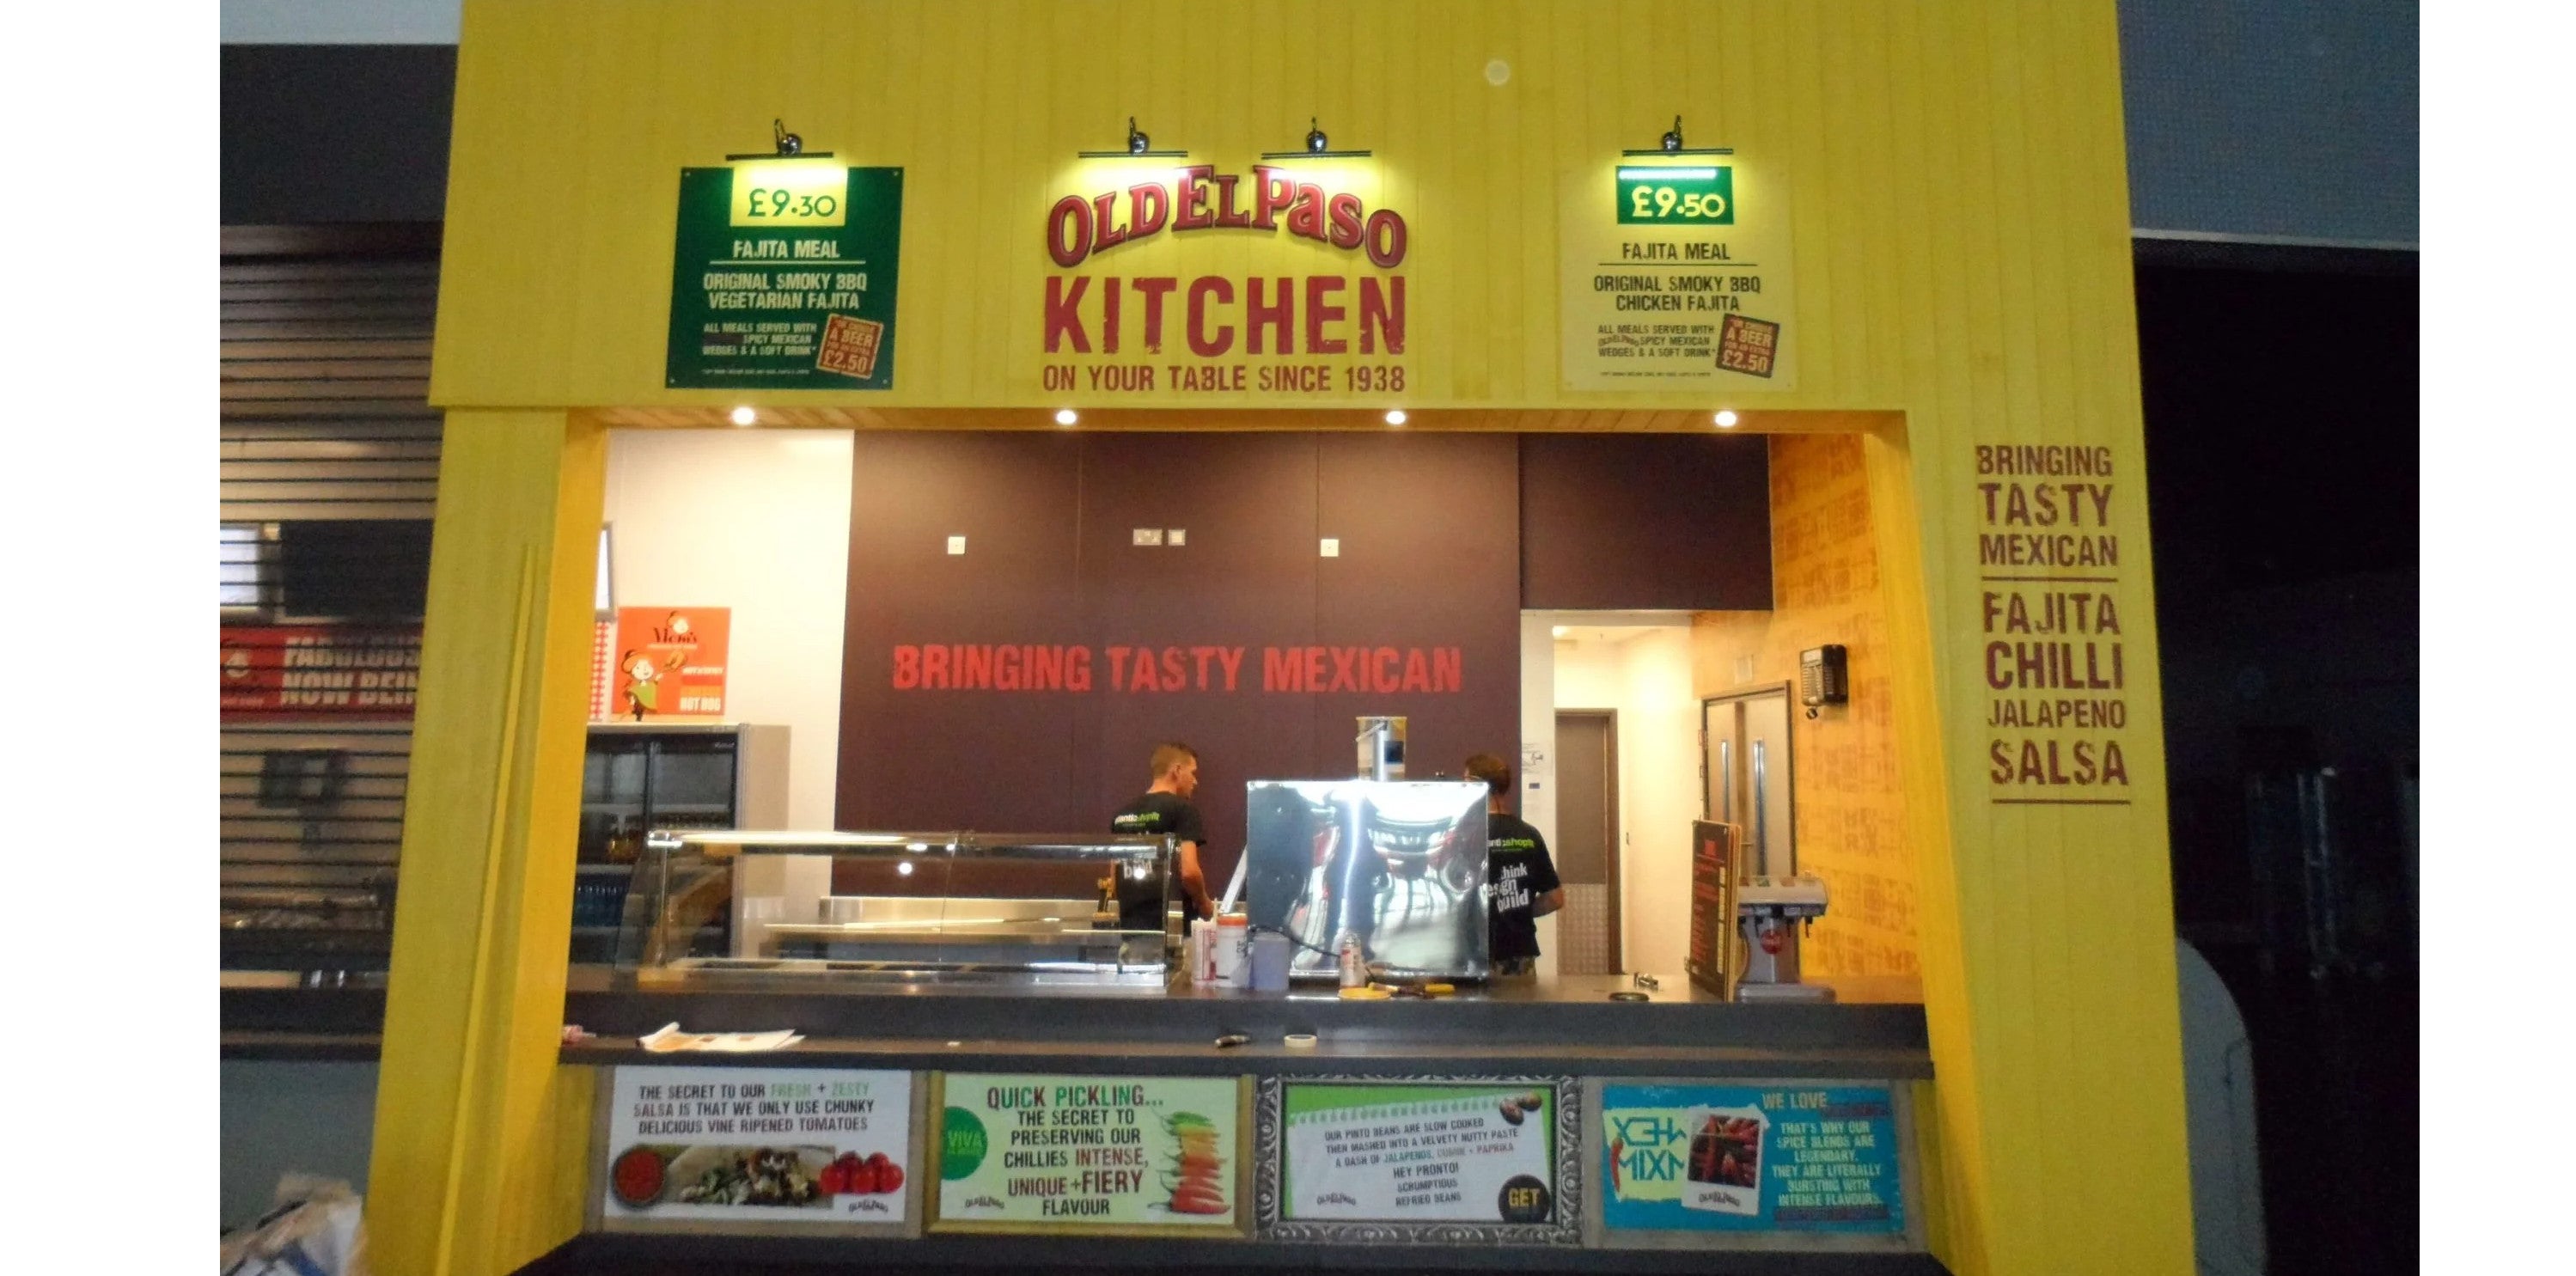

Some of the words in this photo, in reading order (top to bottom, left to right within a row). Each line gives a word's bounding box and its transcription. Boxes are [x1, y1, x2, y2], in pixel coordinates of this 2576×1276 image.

[748, 188, 836, 217] £9.30
[1632, 186, 1725, 217] £9.50
[733, 240, 788, 258] FAJITA
[794, 240, 840, 258] MEAL
[1622, 242, 1678, 259] FAJITA
[1684, 243, 1731, 259] MEAL
[703, 273, 771, 290] ORIGINAL
[776, 273, 831, 290] SMOKY
[836, 273, 867, 291] BBQ
[1594, 275, 1662, 292] ORIGINAL
[1669, 276, 1724, 293] SMOKY
[1730, 276, 1761, 294] BBQ
[709, 292, 803, 309] VEGETARIAN
[808, 292, 859, 309] FAJITA
[1616, 295, 1682, 311] CHICKEN
[1687, 295, 1740, 311] FAJITA
[1044, 276, 1405, 357] KITCHEN
[704, 322, 720, 333] ALL
[1598, 325, 1614, 334] ALL
[1616, 325, 1650, 334] MEALS
[1652, 325, 1687, 334] SERVED
[1691, 325, 1714, 334] WITH
[1726, 327, 1736, 341] A
[1639, 336, 1665, 345] SPICY
[1670, 336, 1710, 345] MEXICAN
[1598, 347, 1634, 357] WEDGES
[1648, 347, 1655, 357] A
[1658, 347, 1680, 357] SOFT
[822, 350, 868, 373] £2.50
[1722, 350, 1767, 373] £2.50
[1043, 366, 1076, 391] ON
[1088, 366, 1154, 391] YOUR
[1168, 366, 1246, 391] TABLE
[1258, 365, 1331, 391] SINCE
[1346, 365, 1406, 392] 1938
[1975, 445, 2113, 478] BRINGING
[1978, 483, 2113, 527] TASTY
[1980, 534, 2117, 567] MEXICAN
[1983, 591, 2121, 634] FAJITA
[893, 644, 1092, 691] BRINGING
[1105, 645, 1245, 693] TASTY
[1263, 646, 1462, 693] MEXICAN
[1986, 641, 2124, 690] CHILLI
[1987, 699, 2126, 729] JALAPENO
[1990, 740, 2129, 786] SALSA
[639, 1085, 662, 1099] THE
[668, 1085, 715, 1099] SECRET
[721, 1084, 736, 1098] TO
[741, 1084, 765, 1097] OUR
[987, 1086, 1046, 1110] QUICK
[1761, 1093, 1785, 1108] WE
[1790, 1092, 1828, 1108] LOVE
[634, 1102, 674, 1117] SALSA
[679, 1102, 690, 1116] IS
[697, 1102, 728, 1115] THAT
[733, 1102, 752, 1115] WE
[759, 1101, 790, 1114] ONLY
[796, 1100, 819, 1114] USE
[825, 1099, 874, 1113] CHUNKY
[1017, 1110, 1045, 1126] THE
[1052, 1109, 1108, 1126] SECRET
[1117, 1108, 1134, 1124] TO
[638, 1120, 702, 1134] DELICIOUS
[708, 1120, 735, 1133] VINE
[741, 1119, 793, 1133] RIPENED
[800, 1117, 868, 1131] TOMATOES
[1325, 1130, 1342, 1141] OUR
[1346, 1127, 1370, 1139] PINTO
[1373, 1126, 1401, 1137] BEANS
[1404, 1123, 1420, 1133] ARE
[1424, 1121, 1447, 1132] SLOW
[1450, 1118, 1484, 1130] COOKED
[1011, 1128, 1104, 1145] PRESERVING
[1111, 1128, 1140, 1144] OUR
[1327, 1144, 1348, 1154] THEN
[1351, 1140, 1386, 1152] MASHED
[1389, 1139, 1408, 1149] INTO
[1412, 1138, 1418, 1147] A
[1420, 1133, 1457, 1145] VELVETY
[1461, 1131, 1488, 1142] NUTTY
[1491, 1128, 1519, 1139] PASTE
[1004, 1151, 1068, 1169] CHILLIES
[1076, 1147, 1149, 1168] INTENSE,
[1344, 1156, 1368, 1166] DASH
[1370, 1154, 1380, 1164] OF
[1393, 1166, 1412, 1179] HEY
[1416, 1162, 1459, 1176] PRONTO!
[1772, 1164, 1798, 1178] THEY
[1827, 1163, 1882, 1176] LITERALLY
[1008, 1177, 1067, 1198] UNIQUE
[1397, 1177, 1458, 1193] SCRUMPTIOUS
[1395, 1194, 1431, 1206] REFRIED
[1434, 1192, 1462, 1203] BEANS
[1509, 1187, 1540, 1209] GET
[1042, 1199, 1110, 1216] FLAVOUR
